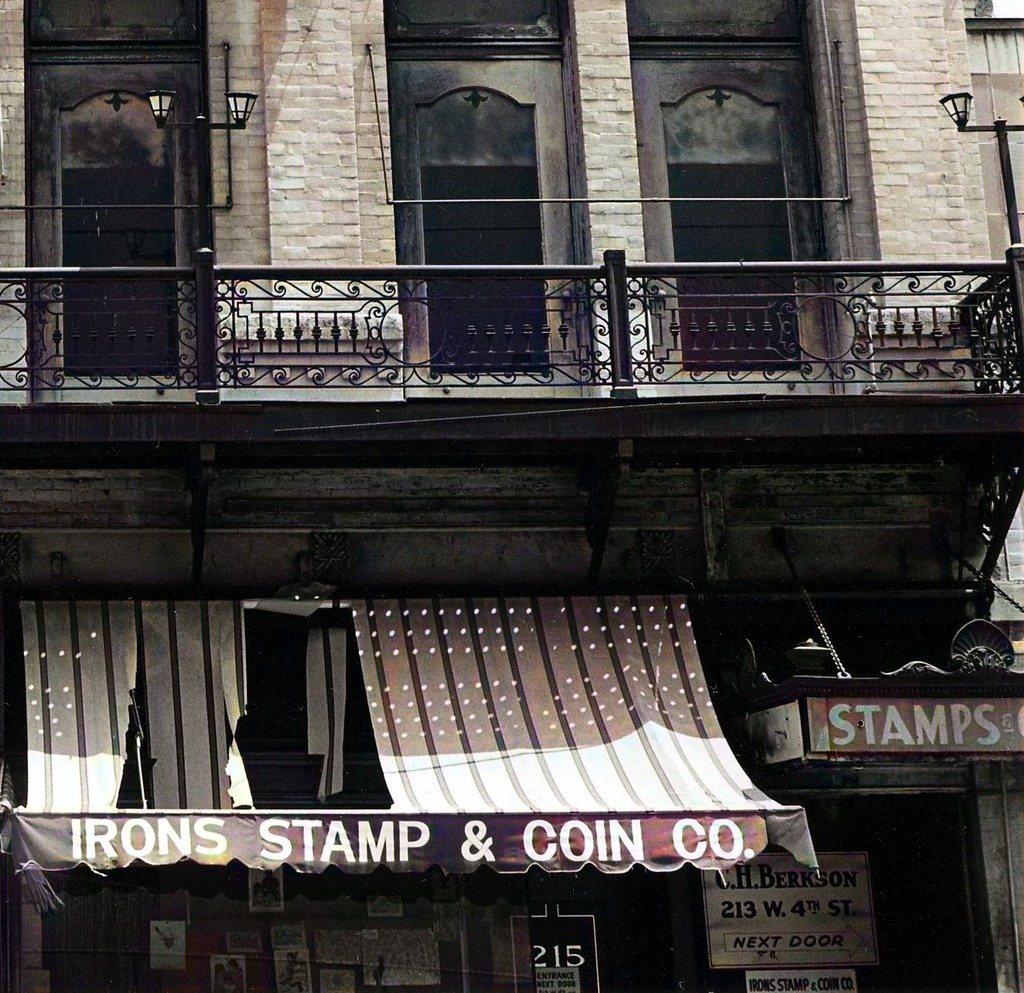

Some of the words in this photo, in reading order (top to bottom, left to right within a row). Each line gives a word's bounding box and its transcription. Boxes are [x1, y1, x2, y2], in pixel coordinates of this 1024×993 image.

[828, 702, 1002, 747] STAMPS
[71, 816, 228, 859] IRONS
[259, 817, 430, 862] STAMP
[460, 819, 497, 862] &
[522, 818, 646, 862] COIN
[672, 818, 755, 860] CO.
[721, 900, 757, 918] 213
[763, 900, 786, 917] W.
[828, 899, 857, 916] ST.
[733, 936, 782, 948] NEXT
[789, 934, 845, 948] DOOR
[533, 945, 585, 967] 215
[537, 972, 575, 980] ENTRANCE
[537, 980, 555, 988] NEXT
[558, 980, 577, 988] DOOR
[749, 978, 776, 992] IRONS
[777, 978, 809, 992] STAMP
[817, 977, 839, 991] COIN
